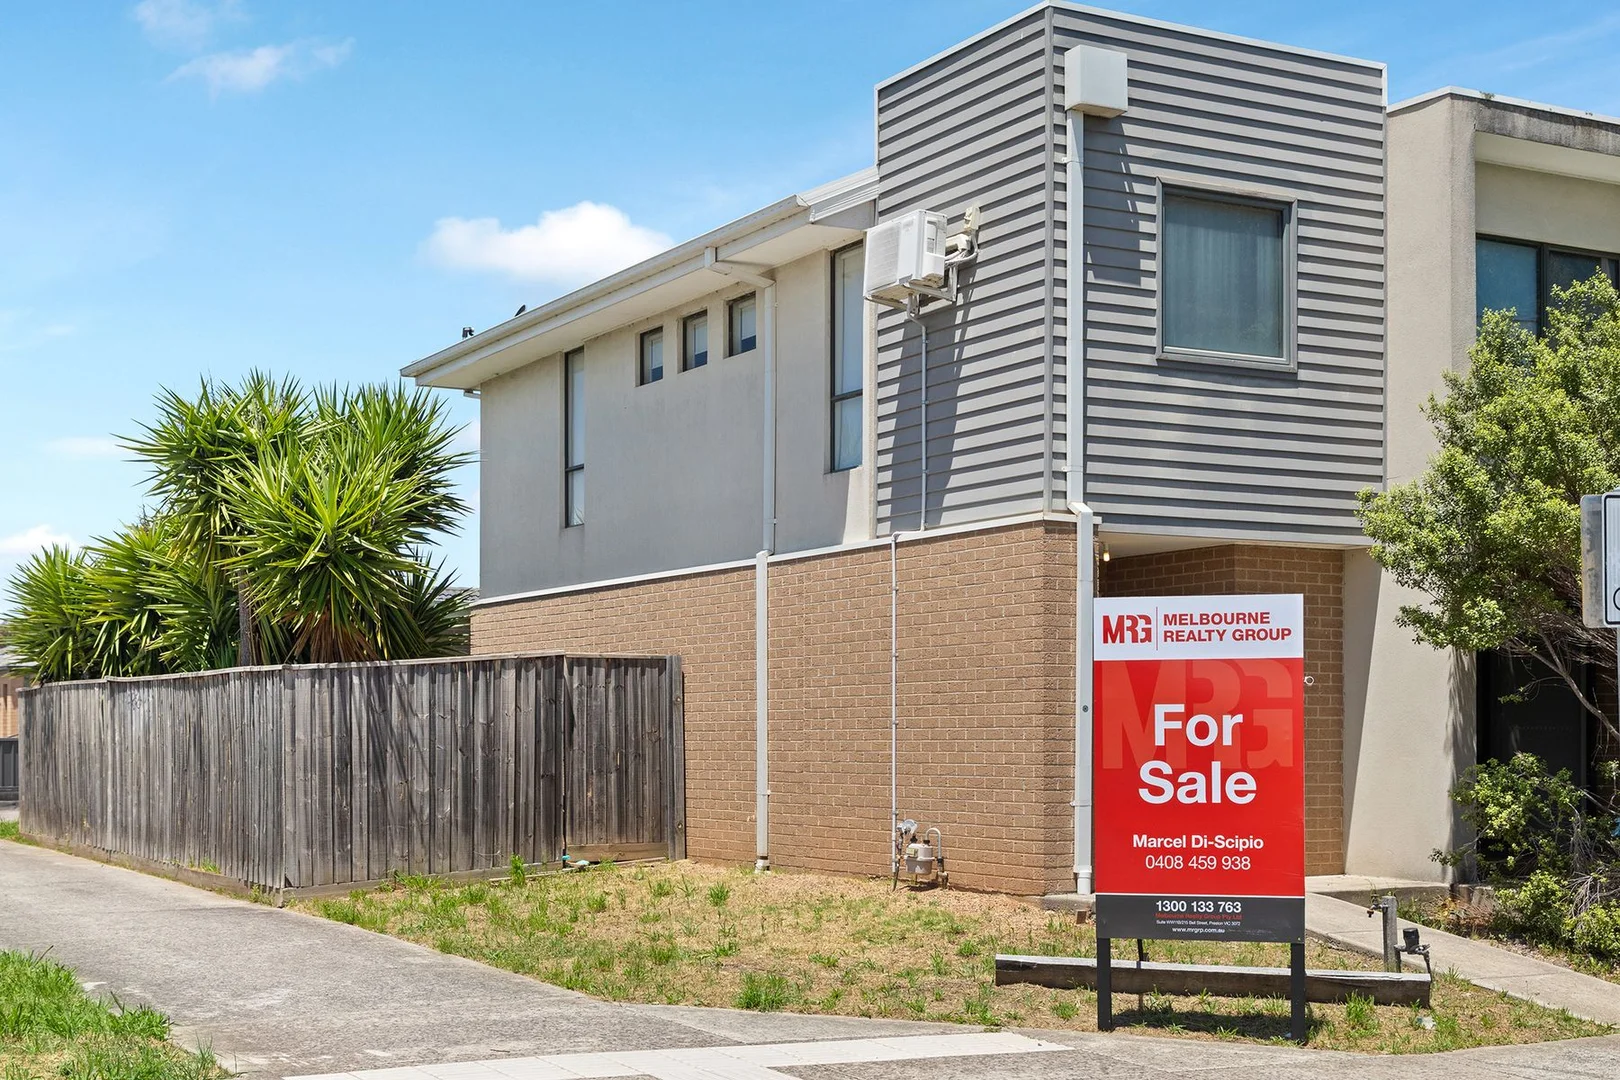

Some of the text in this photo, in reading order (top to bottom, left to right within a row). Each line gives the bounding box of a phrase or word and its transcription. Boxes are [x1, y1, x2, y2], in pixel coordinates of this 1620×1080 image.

[1163, 612, 1270, 626] MELBOURNE
[1102, 614, 1152, 644] MRG
[1163, 628, 1292, 643] REALTY GROUP
[1154, 703, 1243, 747] For
[1138, 760, 1257, 805] Sale
[1132, 834, 1264, 851] Marcel Di-Scipio
[1145, 855, 1251, 871] 0408 459 938
[1156, 900, 1242, 913] 1300 133 763
